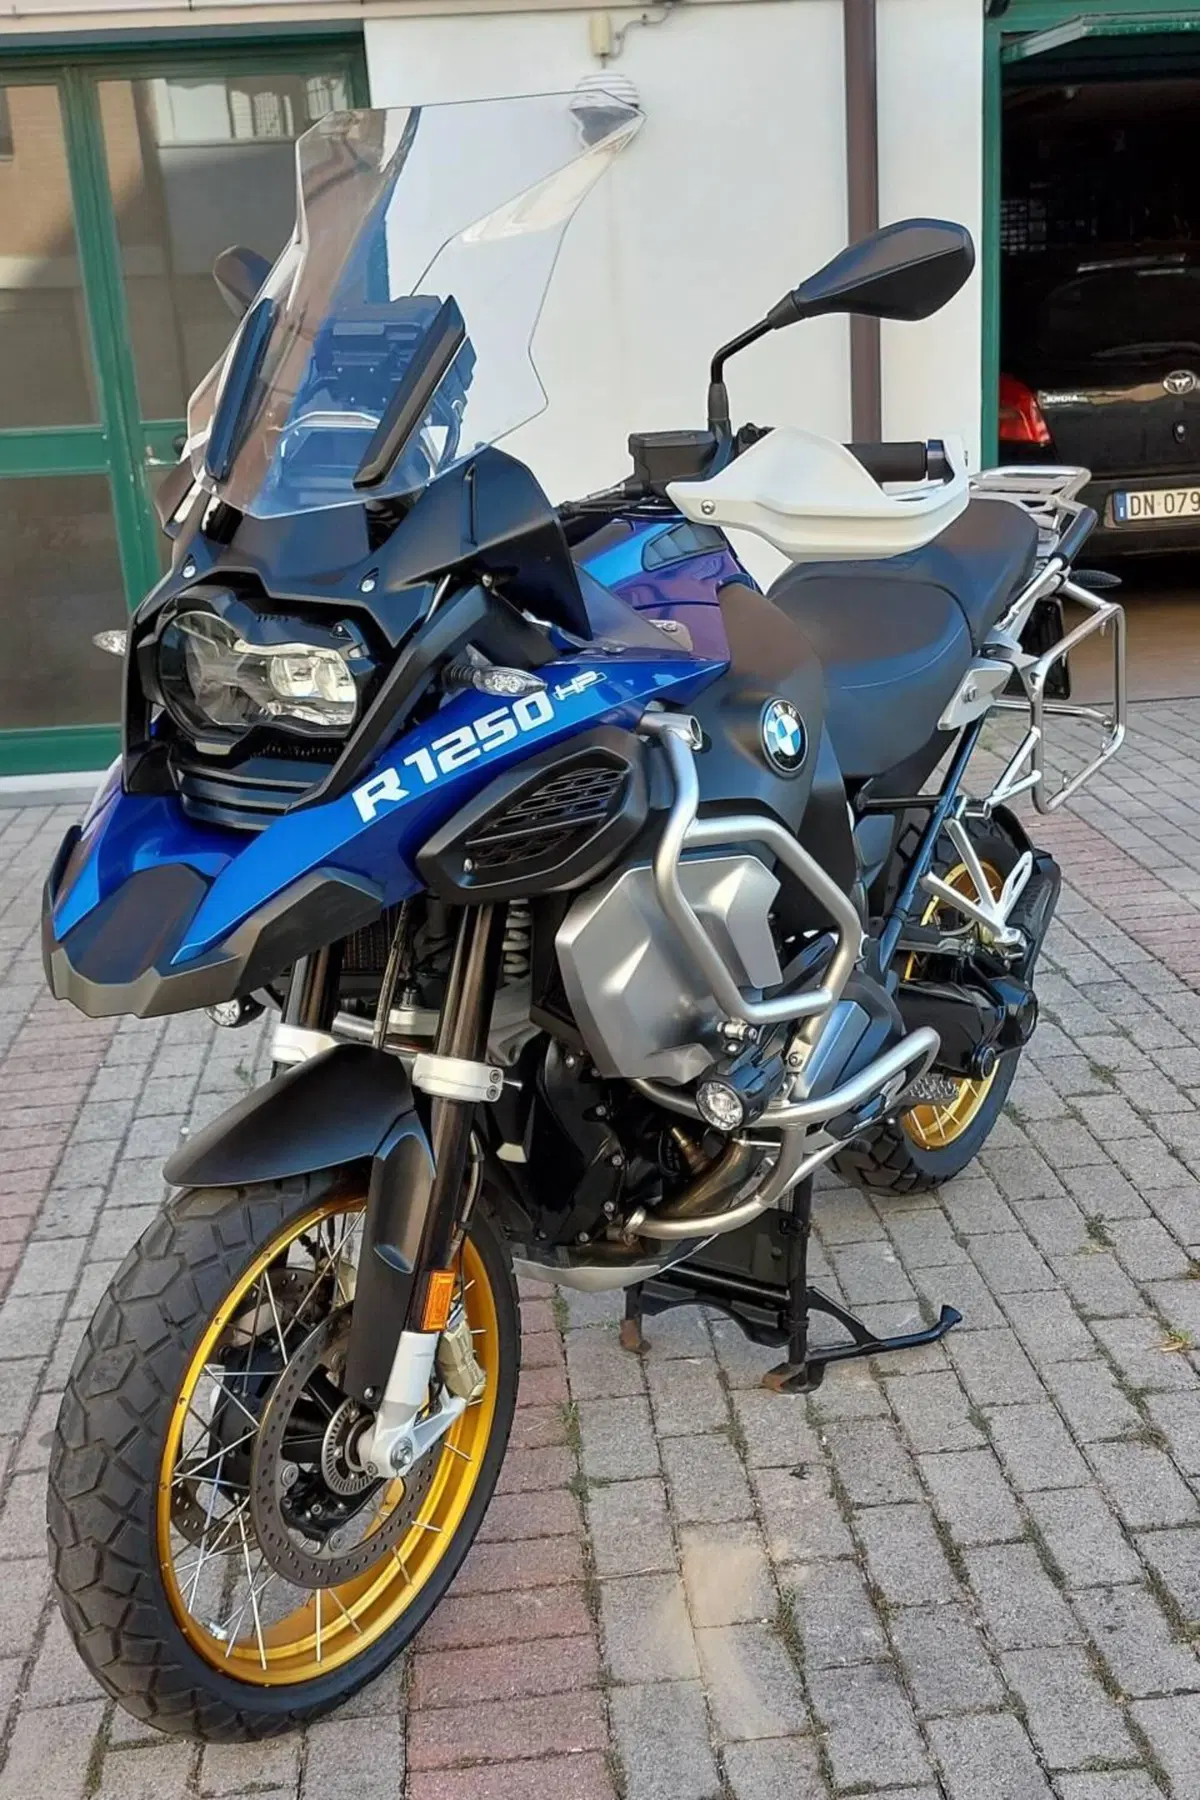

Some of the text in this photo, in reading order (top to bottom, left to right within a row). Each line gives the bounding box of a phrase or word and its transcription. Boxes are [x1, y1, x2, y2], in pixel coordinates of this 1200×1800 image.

[1130, 494, 1155, 516] DN
[1164, 491, 1200, 514] 079
[352, 670, 607, 823] R 1250 HP
